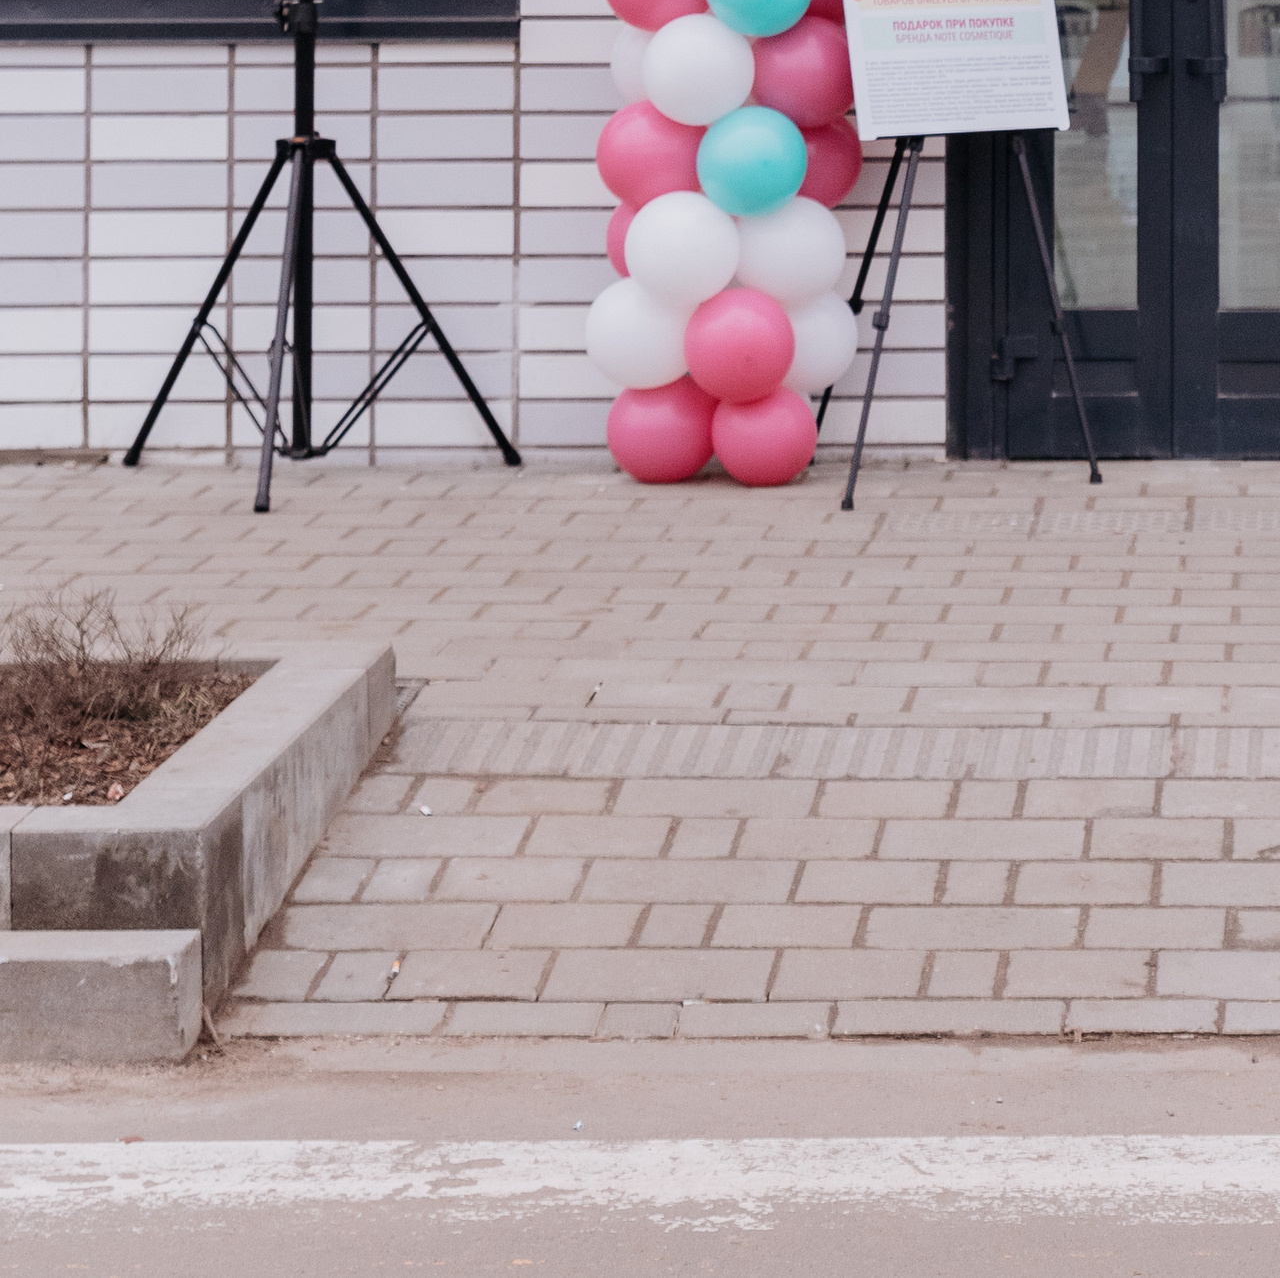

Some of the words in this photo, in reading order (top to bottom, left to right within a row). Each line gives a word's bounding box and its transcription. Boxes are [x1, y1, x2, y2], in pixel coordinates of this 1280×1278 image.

[893, 20, 942, 31] ПОДАРОК
[945, 19, 965, 29] ПРИ
[969, 17, 1015, 28] ПОКУПКЕ
[896, 33, 931, 44] БРЕНДА
[935, 32, 957, 42] NOTE
[960, 30, 1013, 41] COSMETIQUE
